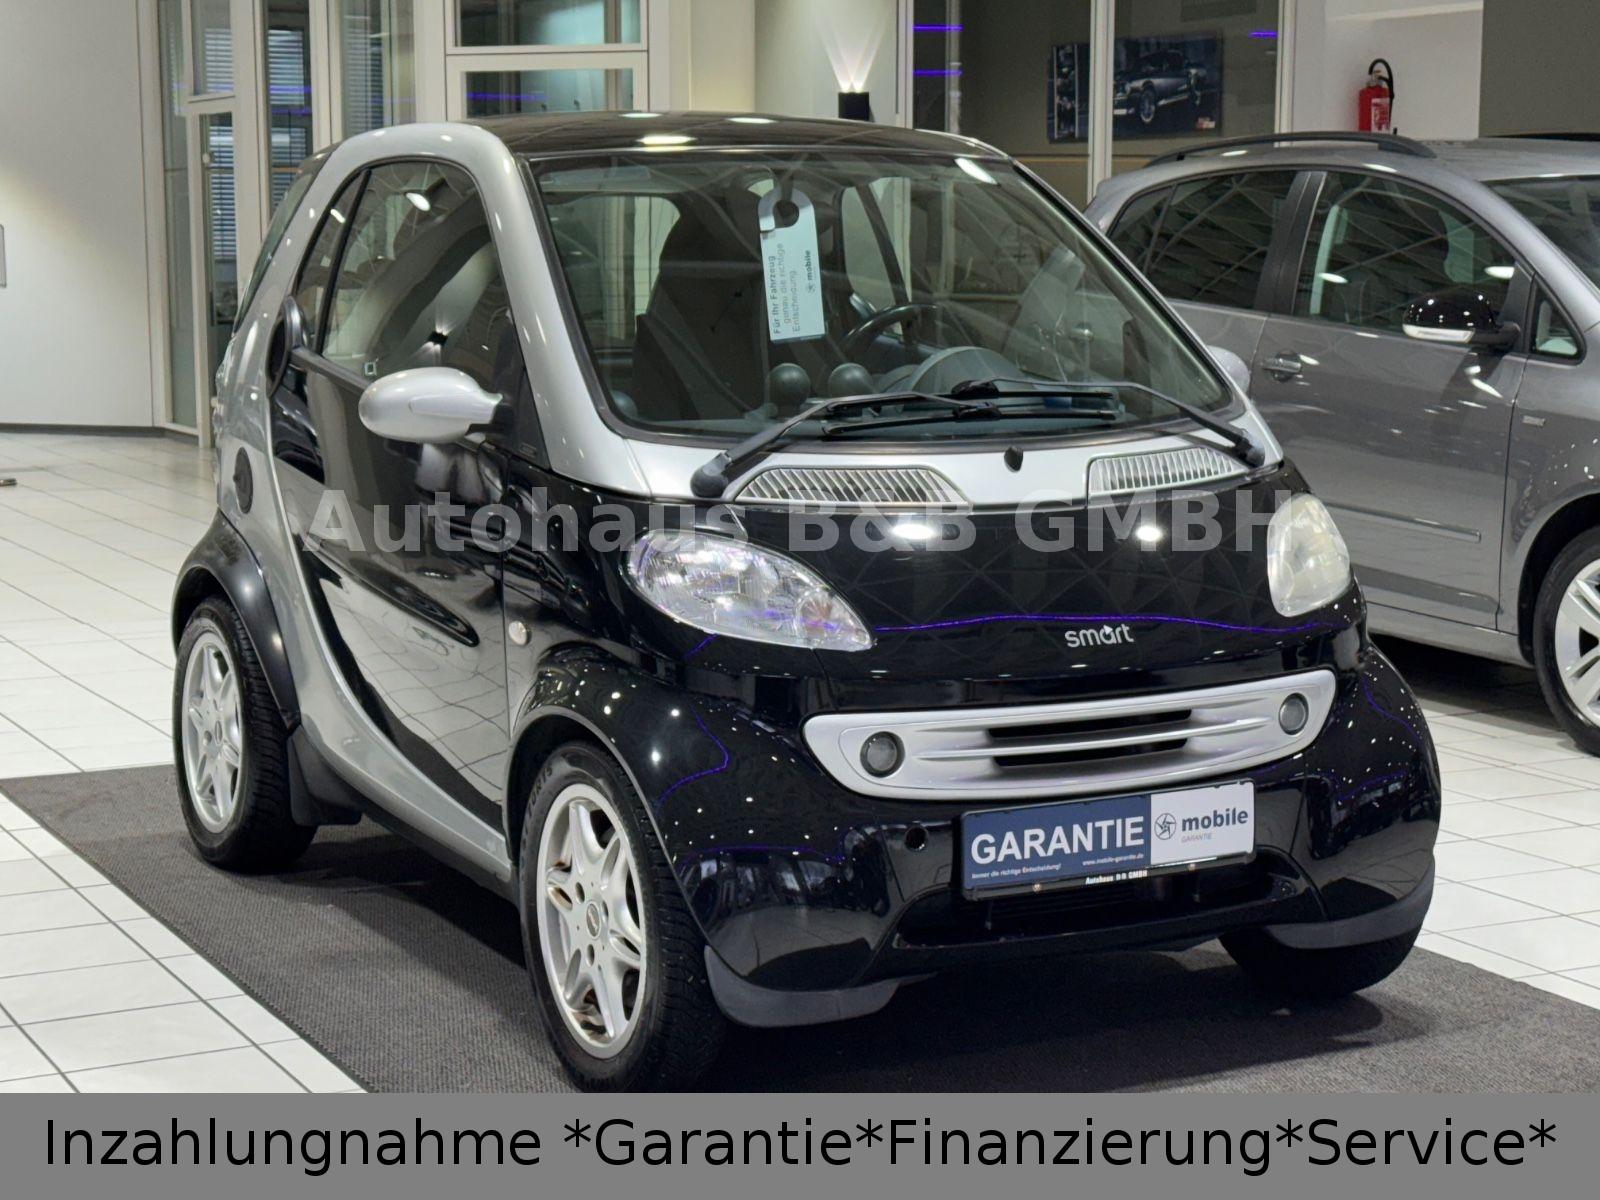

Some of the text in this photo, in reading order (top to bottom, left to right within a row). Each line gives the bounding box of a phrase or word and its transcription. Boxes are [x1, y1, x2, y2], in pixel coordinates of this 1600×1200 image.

[777, 243, 786, 277] richtige
[804, 249, 813, 281] mobile
[768, 255, 778, 300] Fahrzeug
[779, 279, 788, 293] die
[771, 302, 780, 316] Ihr
[1064, 623, 1135, 648] smart
[1181, 807, 1249, 832] mobile
[970, 815, 1145, 865] GARANTIE
[1180, 832, 1213, 843] GARANTIE
